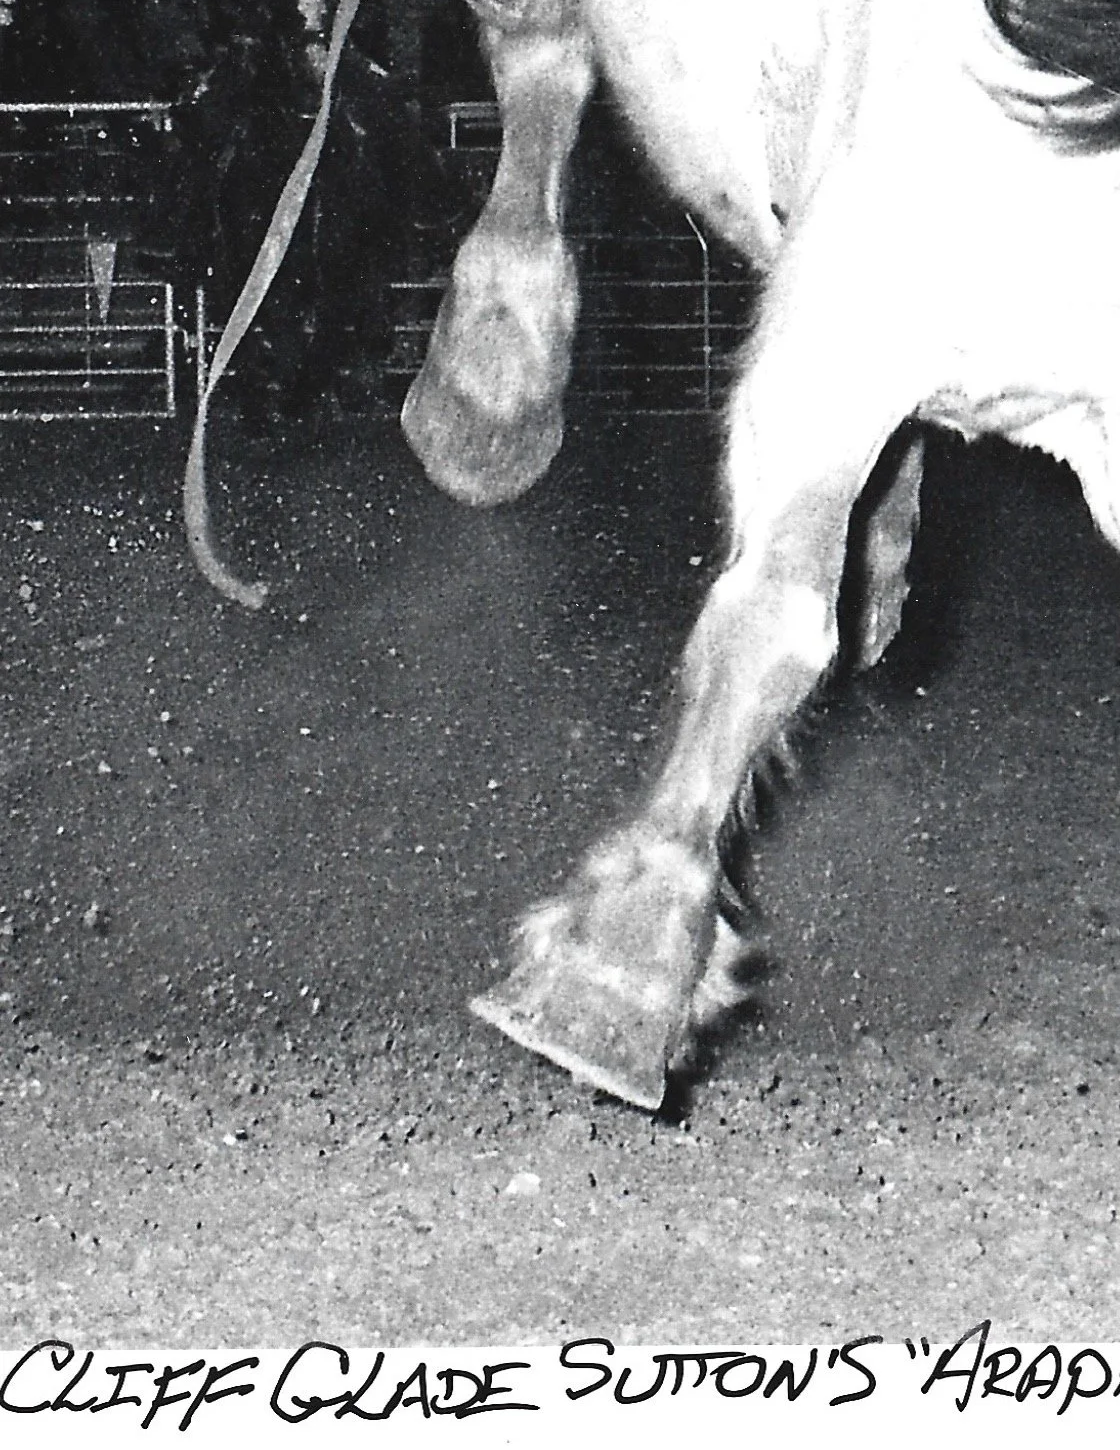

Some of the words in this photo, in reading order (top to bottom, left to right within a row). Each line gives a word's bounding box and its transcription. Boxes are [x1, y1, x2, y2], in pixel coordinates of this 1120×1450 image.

[0, 1340, 260, 1432] CLIFF
[270, 1341, 541, 1424] GLADE
[560, 1336, 884, 1407] SUTTON'S
